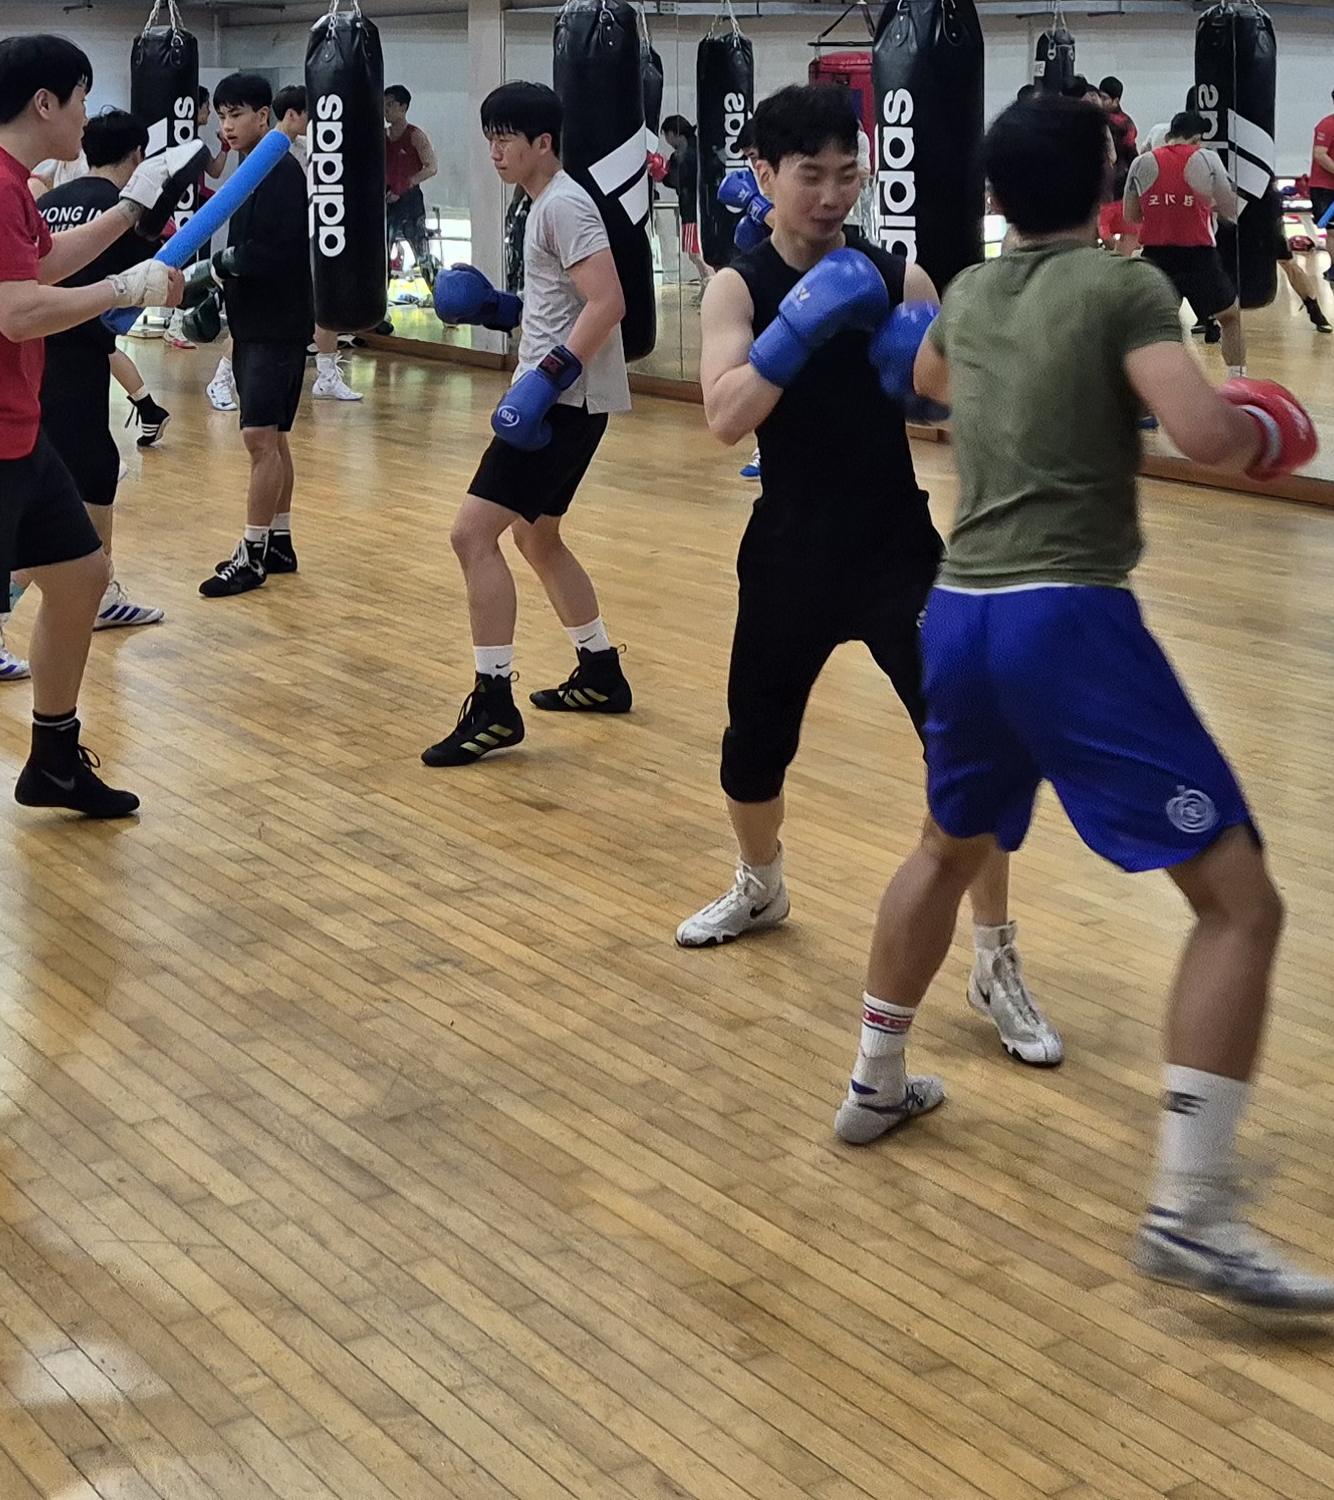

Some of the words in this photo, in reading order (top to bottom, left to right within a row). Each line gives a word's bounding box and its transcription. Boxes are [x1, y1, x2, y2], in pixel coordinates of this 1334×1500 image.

[38, 205, 84, 223] YONG
[311, 93, 346, 258] adidas
[878, 87, 918, 265] didas
